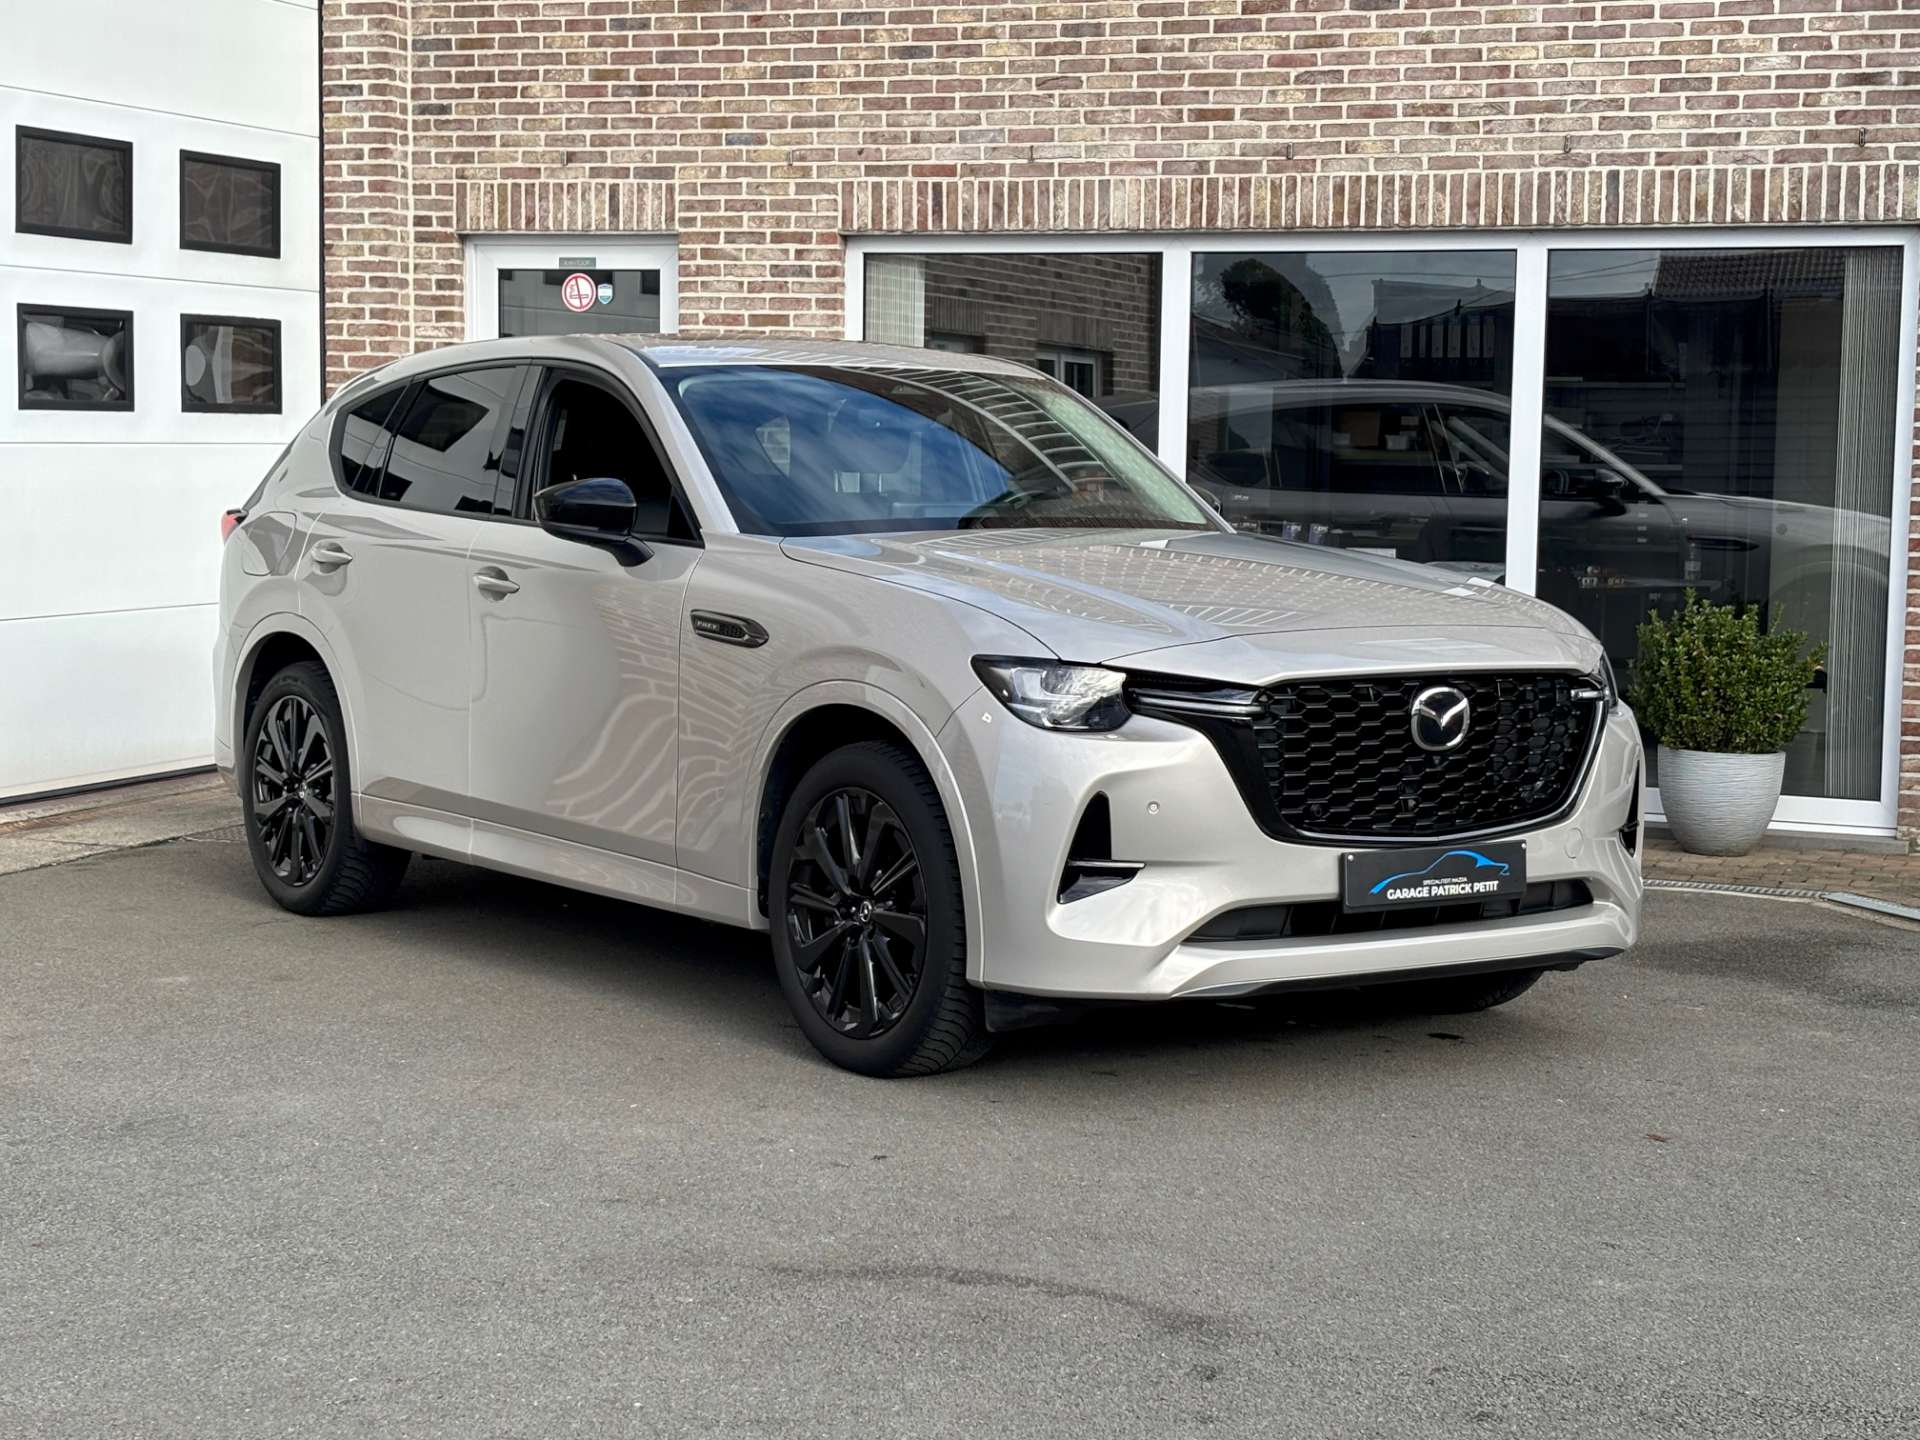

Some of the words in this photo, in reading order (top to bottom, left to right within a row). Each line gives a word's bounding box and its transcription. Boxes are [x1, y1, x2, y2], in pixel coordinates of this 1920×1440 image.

[1387, 887, 1430, 900] GARAGE
[1431, 883, 1472, 897] PATRICK
[1473, 880, 1499, 893] PETIT
